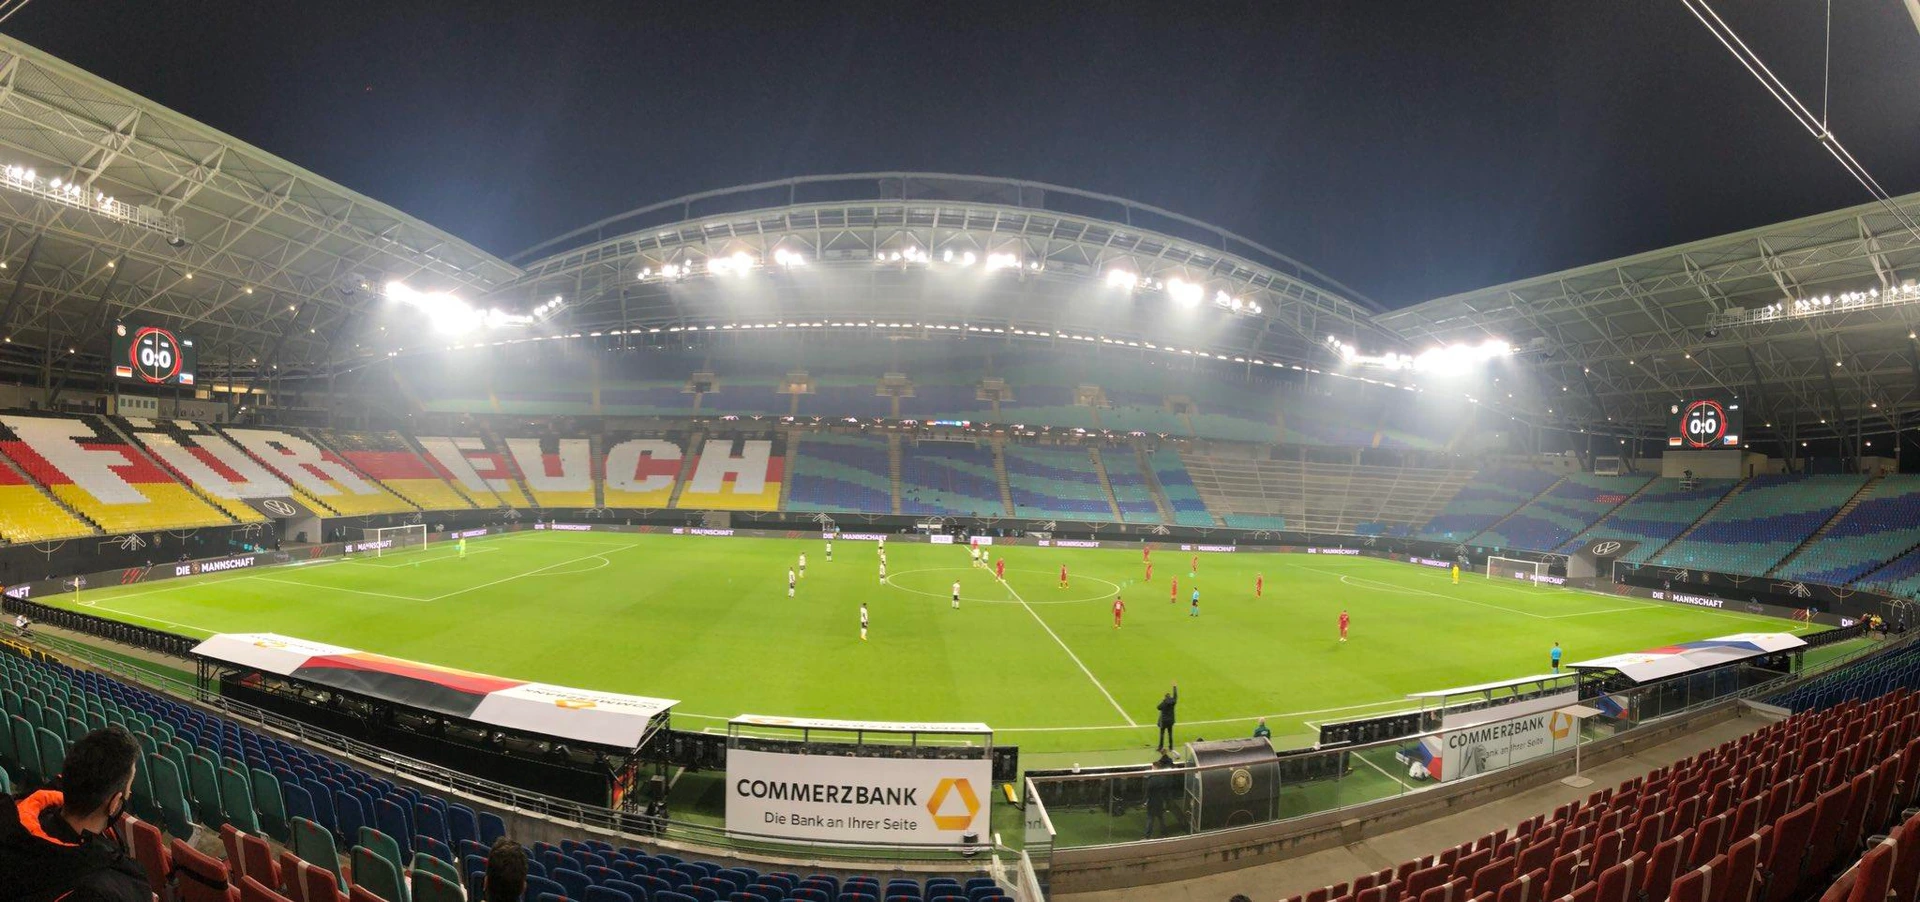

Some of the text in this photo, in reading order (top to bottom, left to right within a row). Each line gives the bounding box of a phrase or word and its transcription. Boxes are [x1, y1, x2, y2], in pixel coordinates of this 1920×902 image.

[142, 348, 171, 368] 0:0
[1690, 418, 1717, 434] 0:0
[415, 436, 772, 494] EUCH
[176, 557, 255, 576] DIE MANNSCHAFT
[1652, 591, 1723, 608] DIE MANNSCHAFT
[1449, 716, 1544, 749] COMMERZBANK
[736, 779, 918, 806] COMMERZBANK
[764, 811, 917, 831] Die Bank an Ihrer Seite
